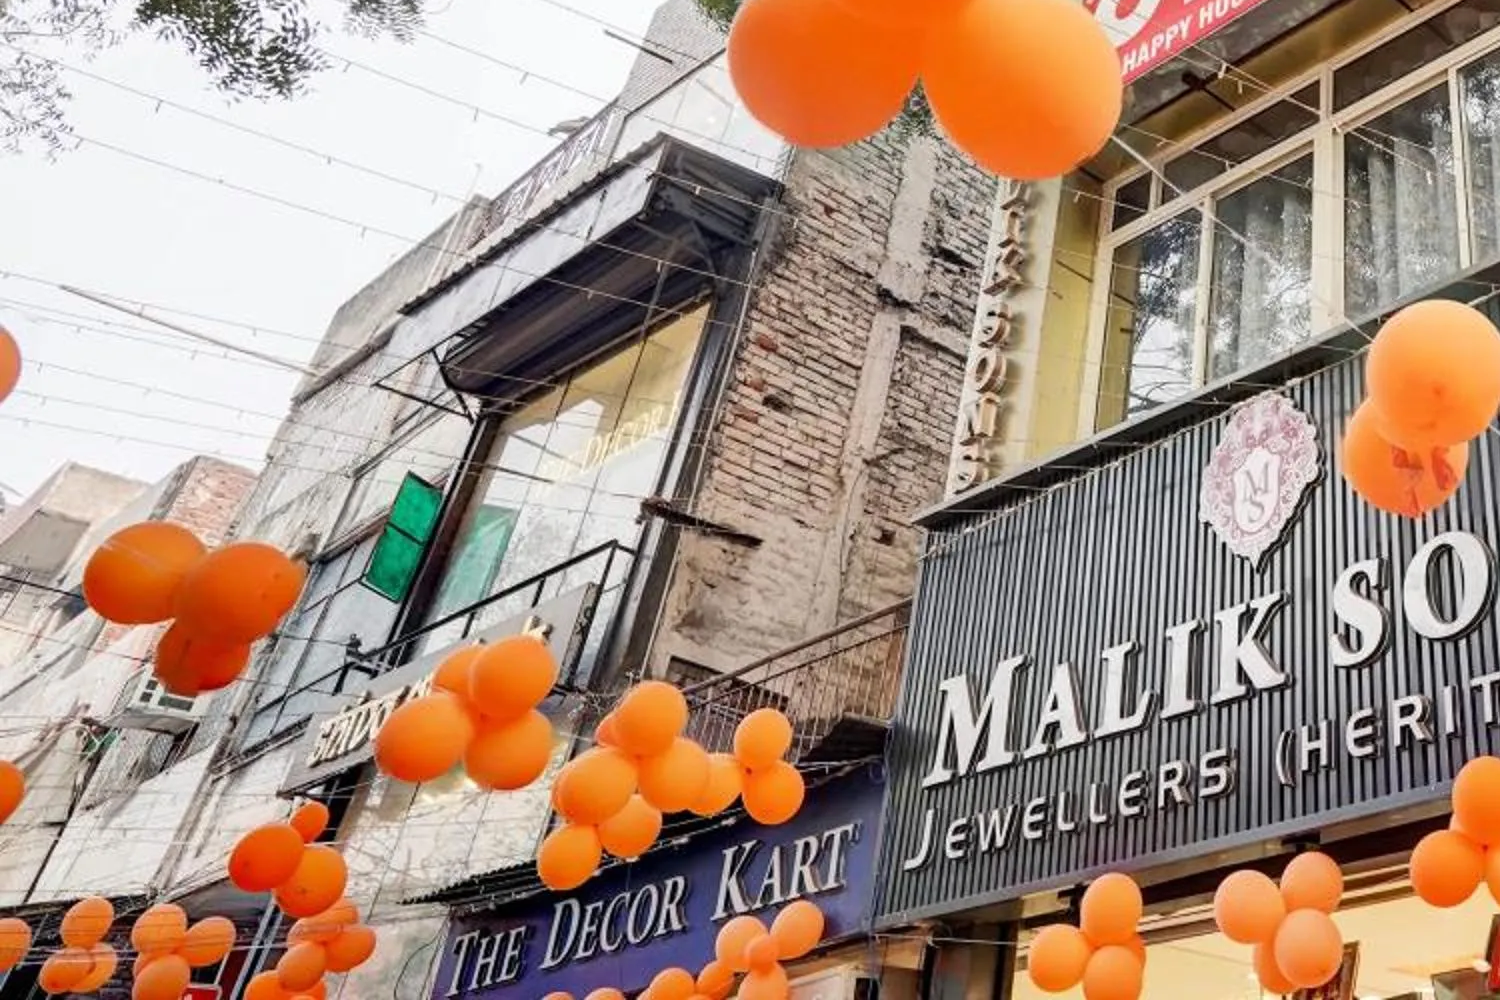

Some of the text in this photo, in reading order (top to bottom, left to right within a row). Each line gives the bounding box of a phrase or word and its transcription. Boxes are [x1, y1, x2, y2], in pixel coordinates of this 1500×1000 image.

[1120, 14, 1193, 76] HAPPY
[921, 590, 1293, 790] MALIK
[904, 748, 1238, 872] JEWELLERS
[445, 823, 858, 1000] THE DECOR KART
